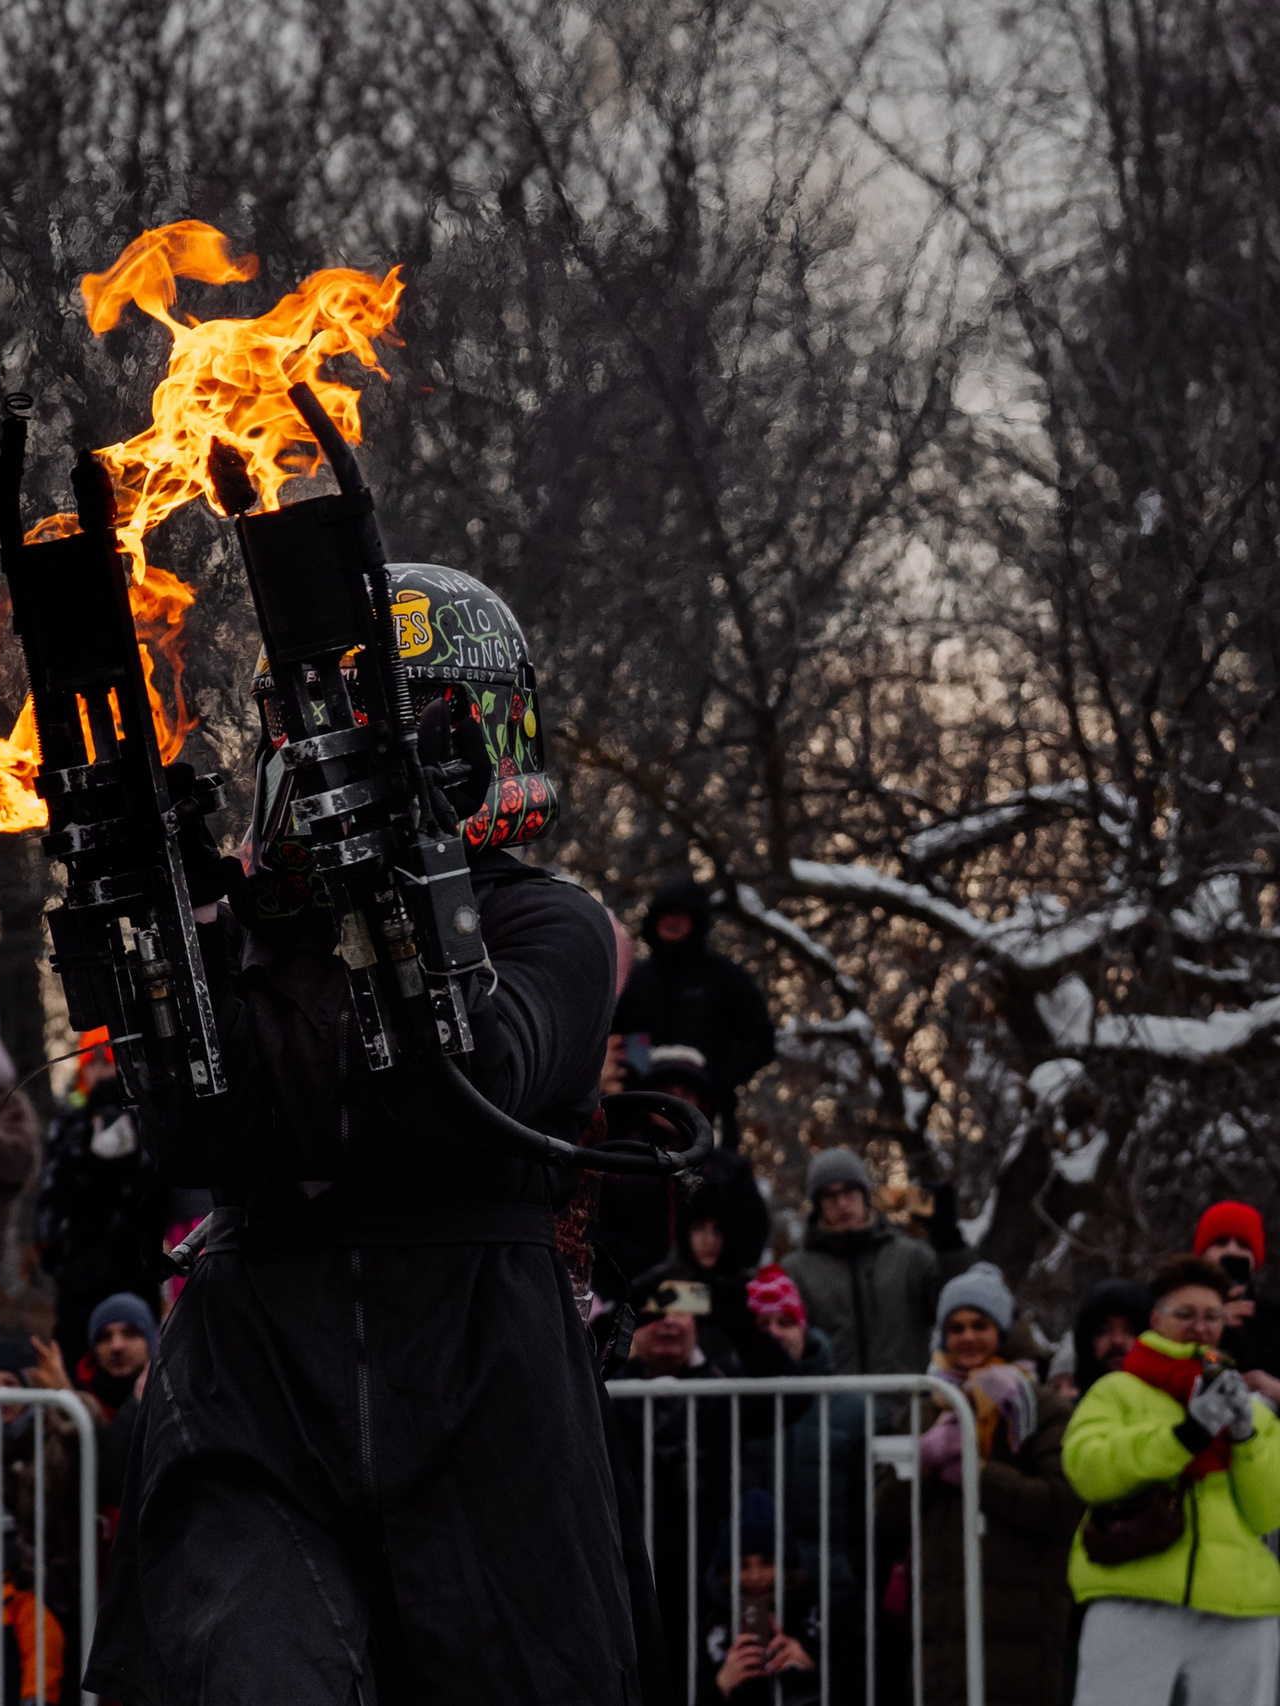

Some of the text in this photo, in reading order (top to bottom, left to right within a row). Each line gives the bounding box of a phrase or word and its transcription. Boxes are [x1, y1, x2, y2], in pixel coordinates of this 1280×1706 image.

[393, 611, 430, 649] ES
[406, 666, 495, 683] IT'S SO EASY
